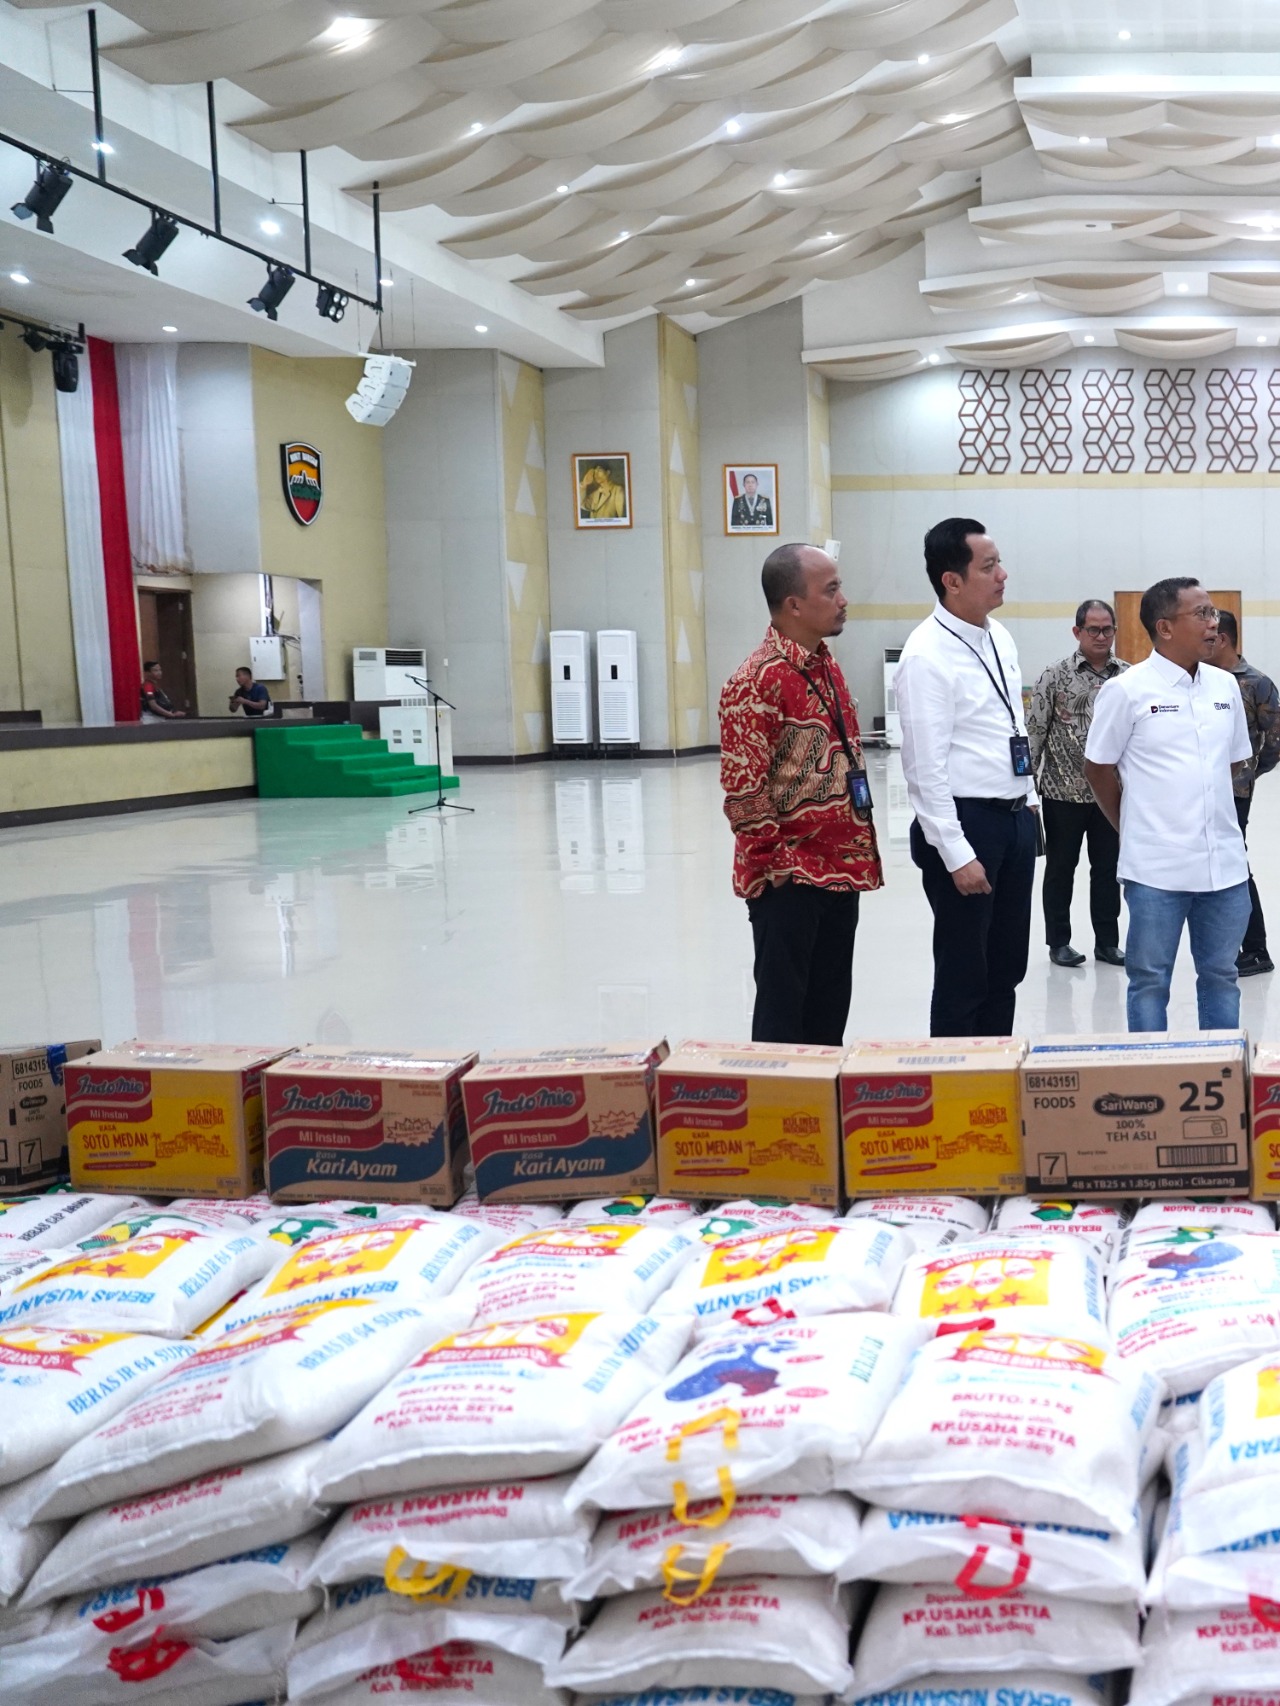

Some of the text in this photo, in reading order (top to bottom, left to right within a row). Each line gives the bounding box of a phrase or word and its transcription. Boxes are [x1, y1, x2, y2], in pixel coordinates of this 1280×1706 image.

[18, 1078, 43, 1092] FOODS
[1028, 1075, 1076, 1089] 68143151
[1033, 1096, 1076, 1109] FOODS
[1179, 1080, 1225, 1113] 25
[1101, 1099, 1158, 1113] SariWangi
[90, 1109, 128, 1120] Mi Instan
[683, 1117, 723, 1128] Mi Instan
[868, 1116, 908, 1125] Mi Instan
[1116, 1119, 1145, 1130] 100%
[83, 1132, 149, 1150] SOTO MEDAN
[299, 1130, 351, 1144] Mi Instan
[503, 1132, 557, 1145] Mi Instan
[1105, 1131, 1157, 1142] TEH ASLI
[25, 1142, 36, 1164] 7
[675, 1139, 743, 1156] SOTO MEDAN
[860, 1136, 930, 1156] SOTO MEDAN
[306, 1157, 398, 1179] Kari Ayam
[514, 1157, 606, 1177] Kari Ayam
[1045, 1156, 1059, 1176] 7
[1072, 1180, 1085, 1190] 48
[1093, 1179, 1119, 1189] TB25
[1129, 1177, 1156, 1190] 1.85g
[1158, 1176, 1184, 1189] (Box)
[1191, 1176, 1236, 1188] Cikarang
[67, 1355, 156, 1415] BERAS IR 64
[1025, 1425, 1077, 1447] SETIA
[402, 1487, 490, 1514] HARAPAN
[353, 1503, 394, 1523] TANI
[727, 1595, 781, 1611] SETIA
[902, 1604, 1052, 1625] KP.USAHA SETIA
[956, 1622, 982, 1636] Deli
[985, 1621, 1035, 1638] Serdang
[1253, 1637, 1278, 1650] Deli
